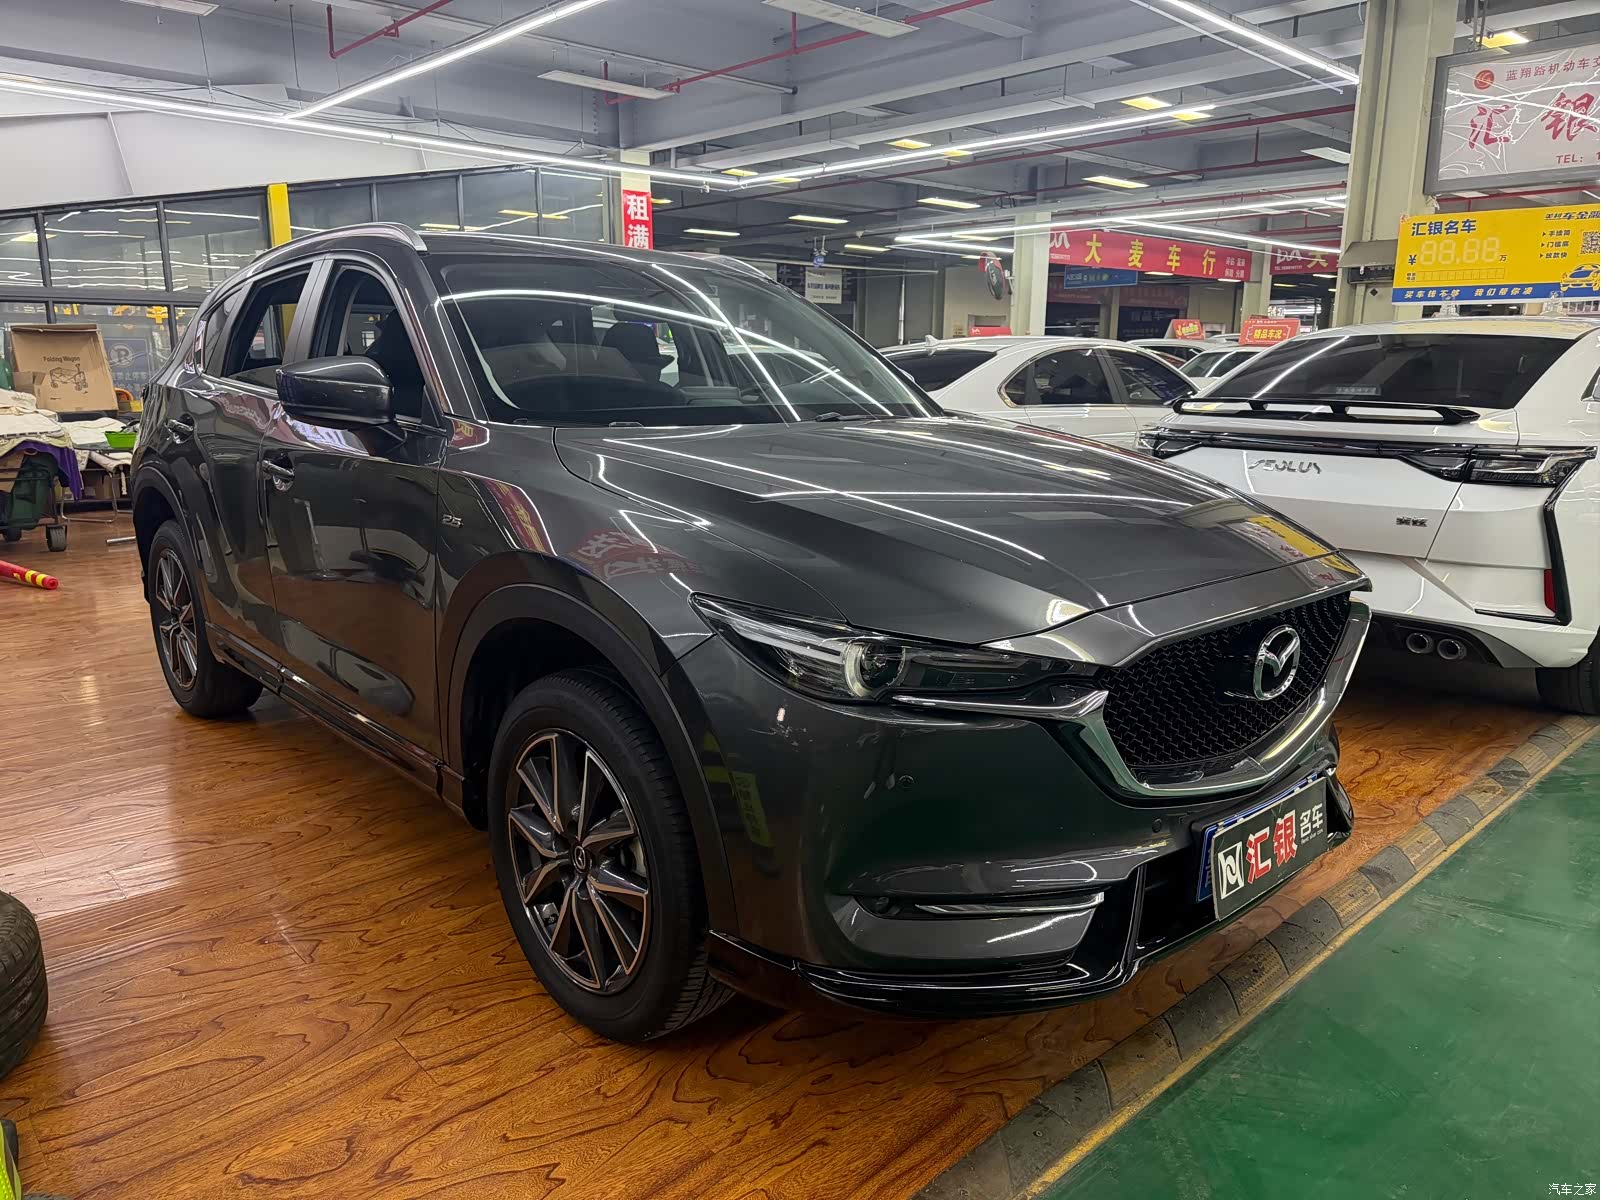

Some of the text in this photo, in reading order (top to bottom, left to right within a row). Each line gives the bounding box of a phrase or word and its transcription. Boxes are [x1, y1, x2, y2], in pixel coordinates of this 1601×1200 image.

[1411, 219, 1477, 237] 汇银名车
[1084, 233, 1216, 276] 大麦车行
